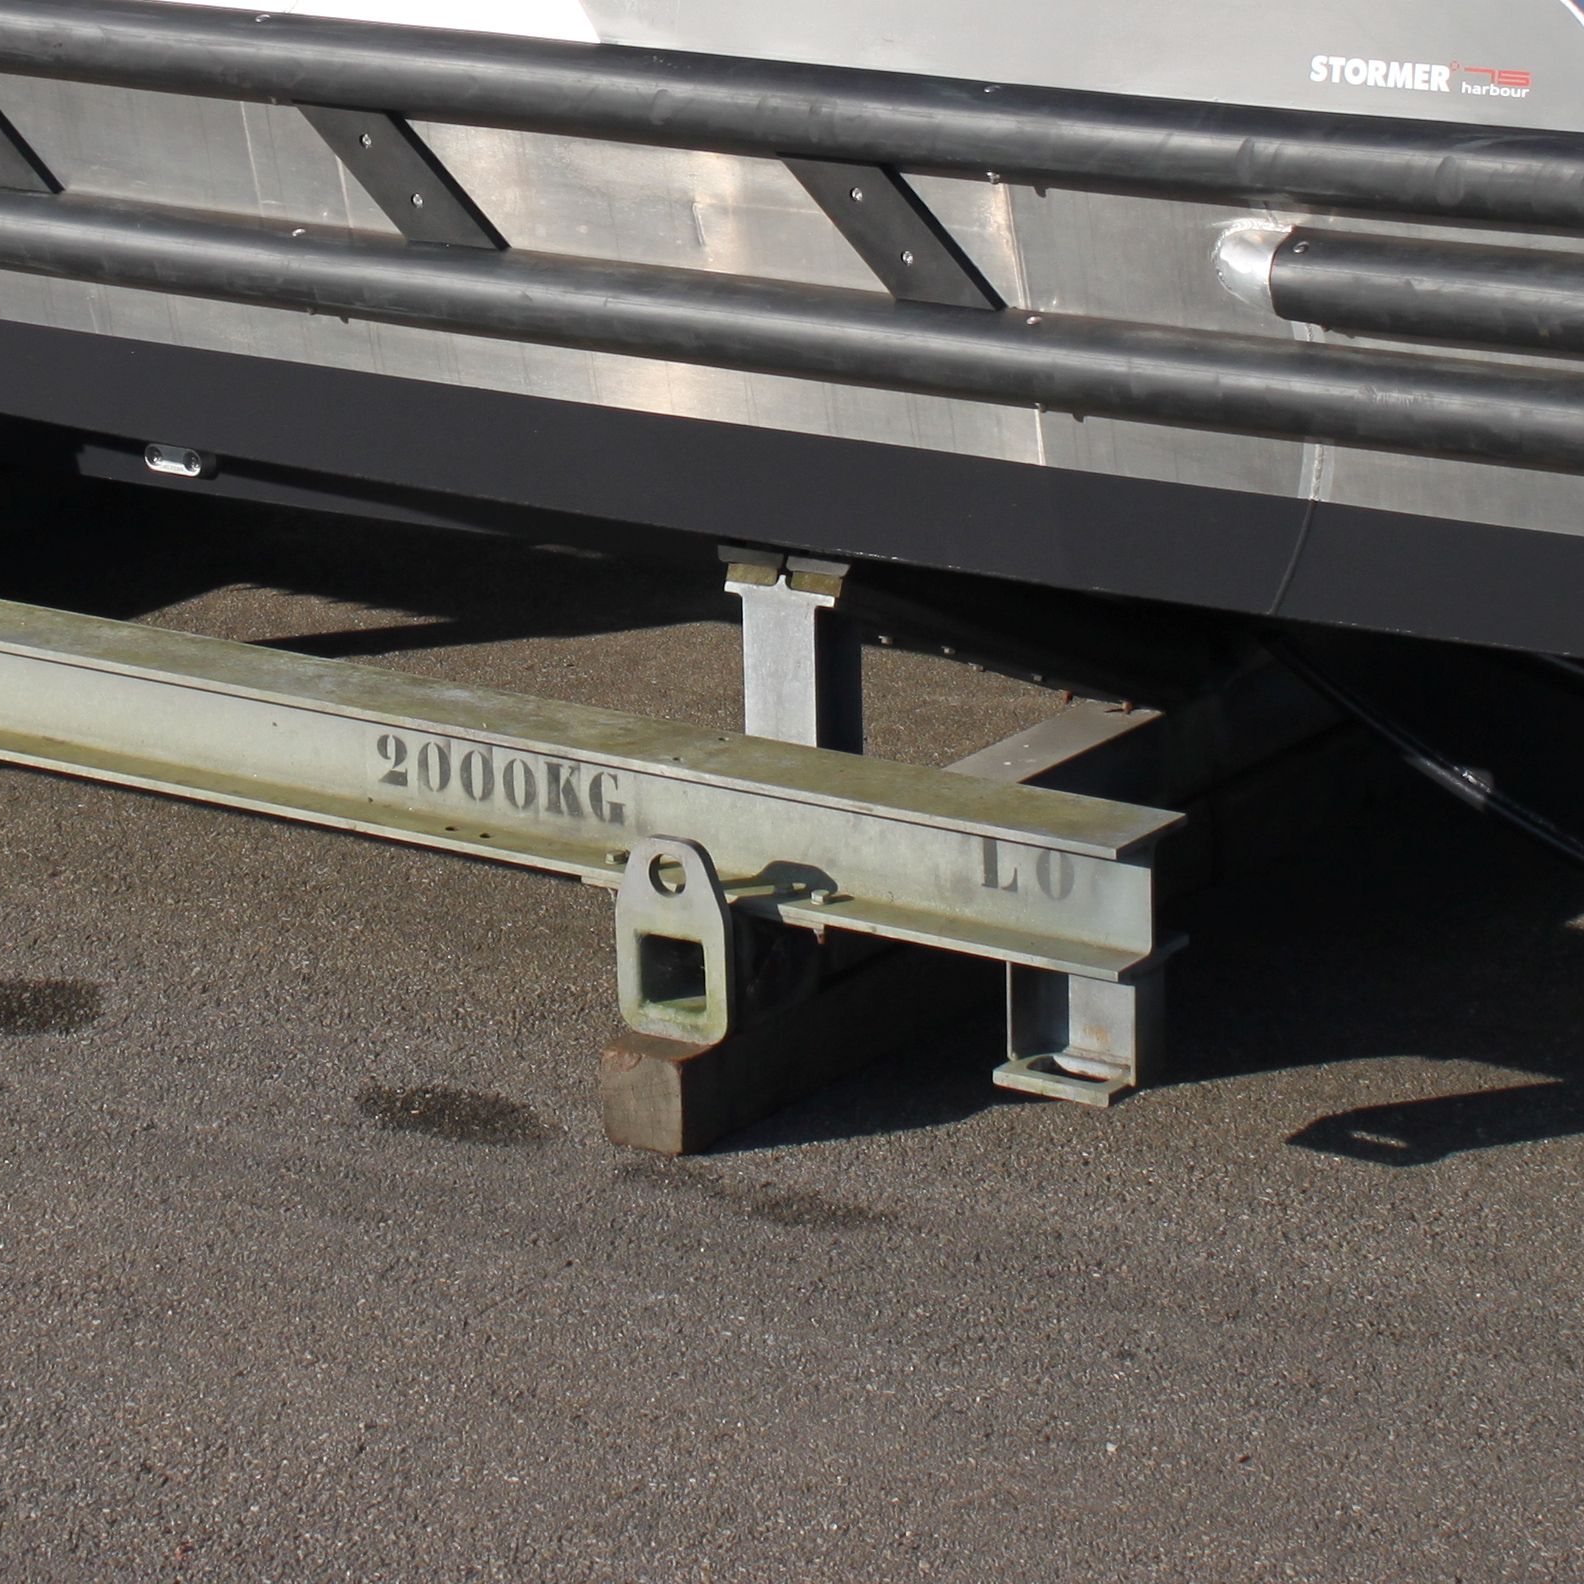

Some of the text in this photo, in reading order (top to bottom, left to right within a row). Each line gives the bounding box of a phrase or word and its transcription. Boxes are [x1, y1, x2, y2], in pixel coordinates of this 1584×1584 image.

[1309, 54, 1451, 93] STORMER
[1460, 80, 1530, 98] harbour
[376, 733, 625, 826] 2000KG
